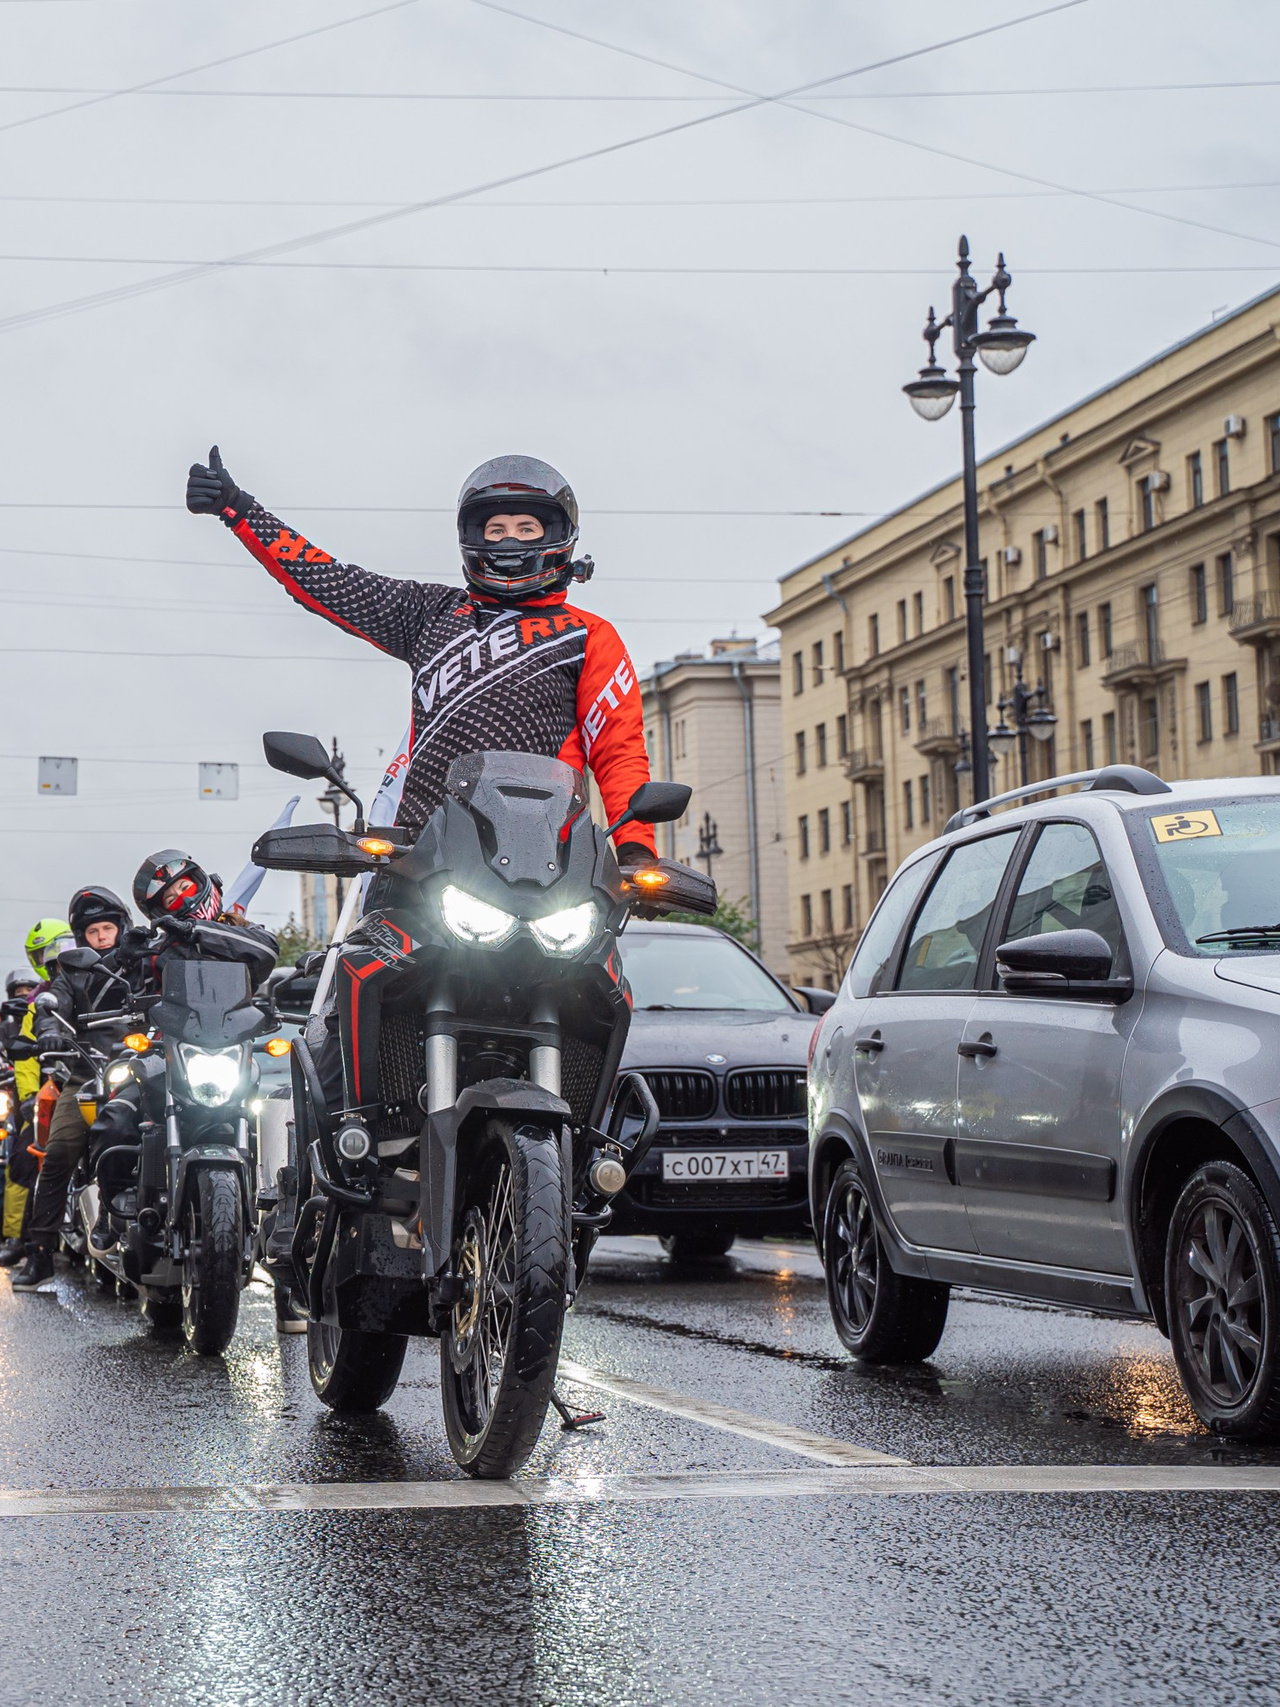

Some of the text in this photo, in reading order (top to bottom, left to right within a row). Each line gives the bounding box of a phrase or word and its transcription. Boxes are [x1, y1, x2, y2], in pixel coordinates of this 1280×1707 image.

[417, 613, 584, 714] VETERR
[672, 1154, 780, 1176] С007ХТ 47
